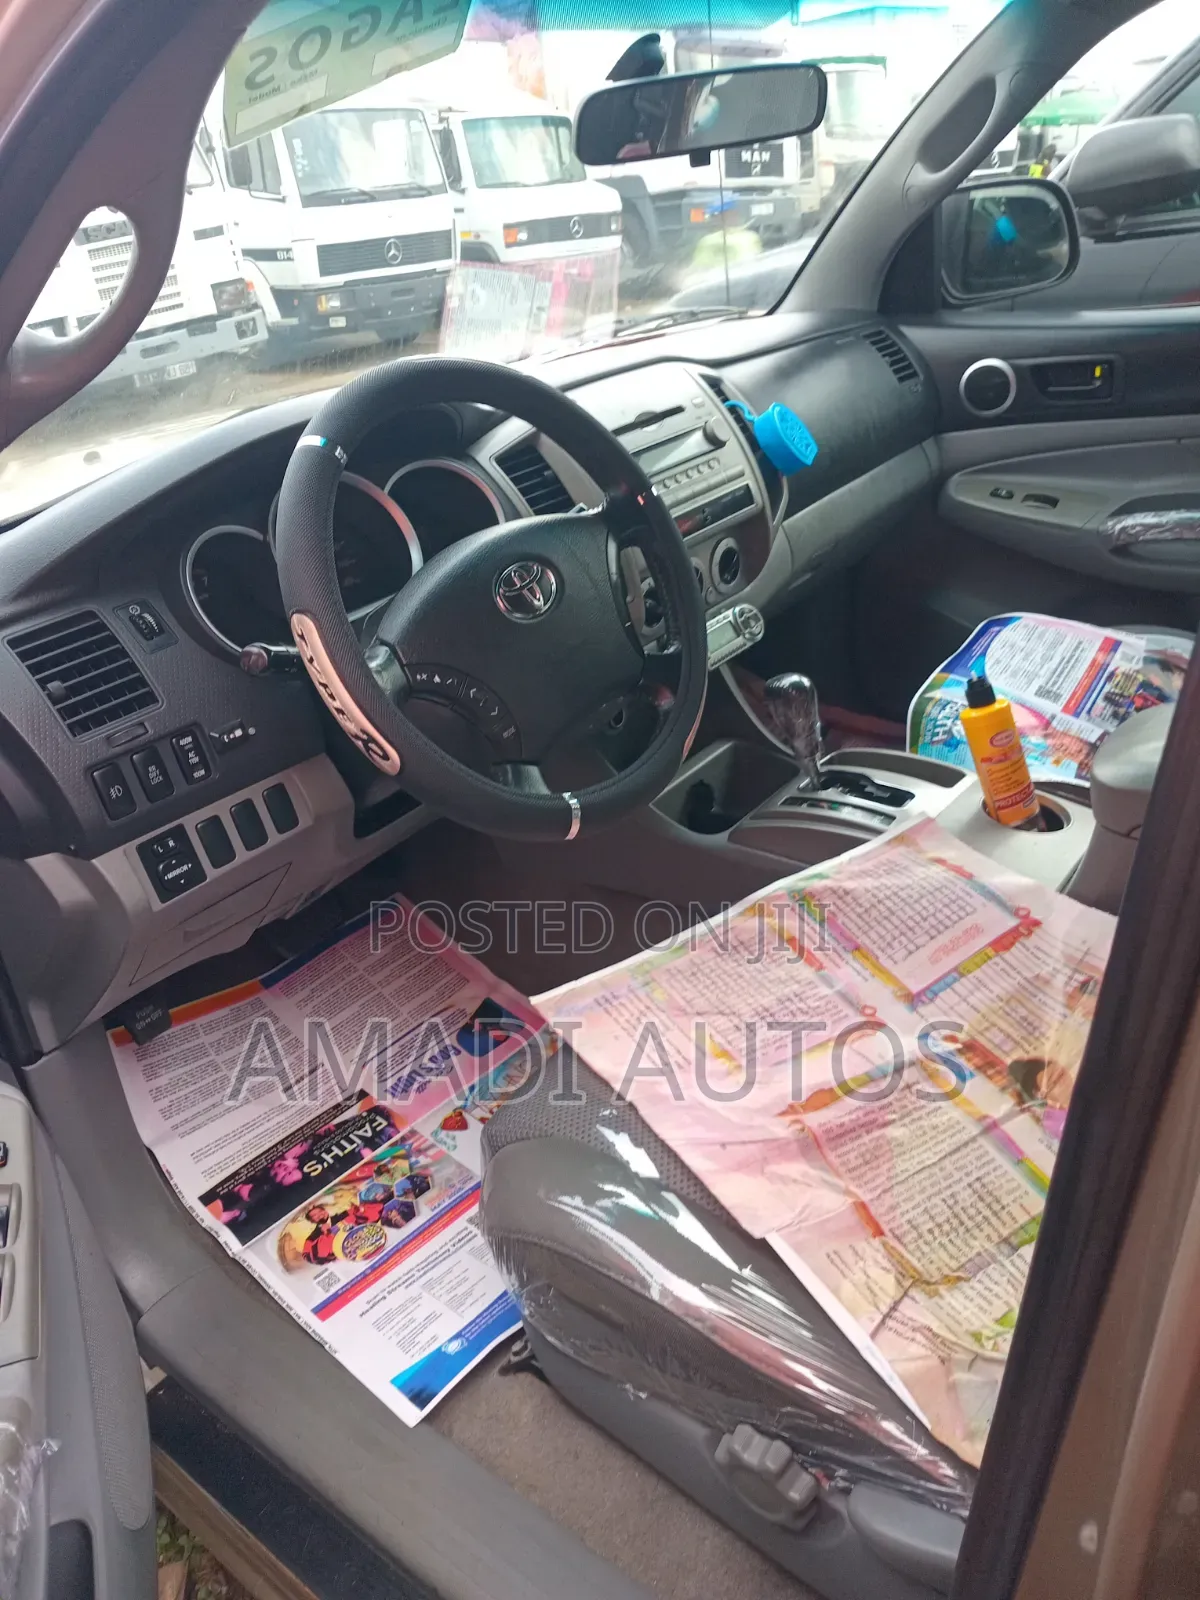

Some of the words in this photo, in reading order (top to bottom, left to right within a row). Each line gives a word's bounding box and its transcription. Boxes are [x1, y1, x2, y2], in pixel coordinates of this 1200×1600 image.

[741, 150, 770, 162] MAN
[150, 776, 164, 785] LOCK
[167, 839, 175, 848] R
[166, 865, 189, 879] MIRROR
[302, 1114, 388, 1177] FAITH'S
